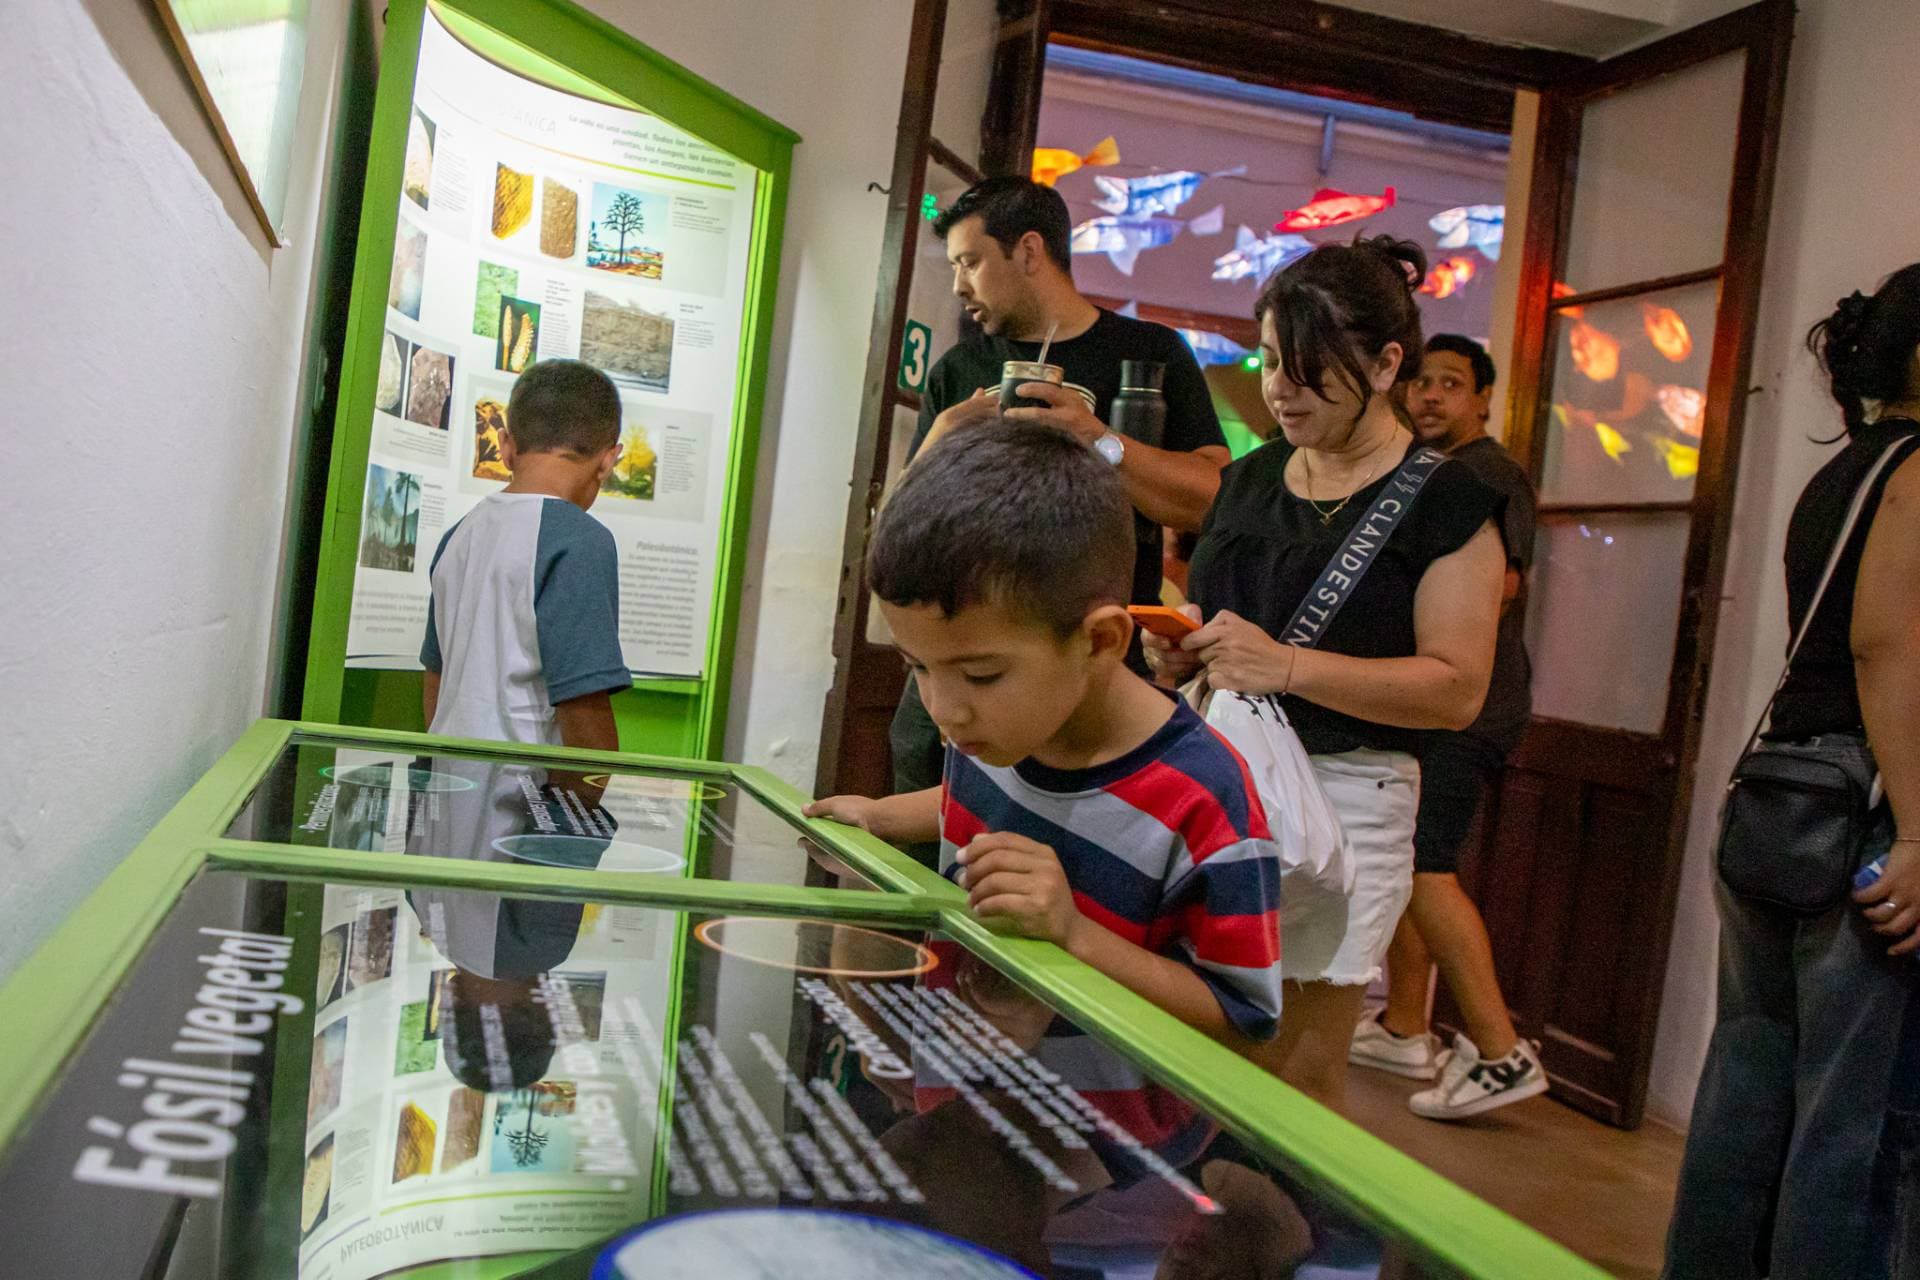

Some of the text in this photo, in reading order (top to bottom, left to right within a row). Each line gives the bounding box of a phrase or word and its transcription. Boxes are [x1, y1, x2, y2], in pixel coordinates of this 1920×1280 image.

[904, 327, 927, 388] 3
[73, 926, 305, 1198] Fósil vegetal
